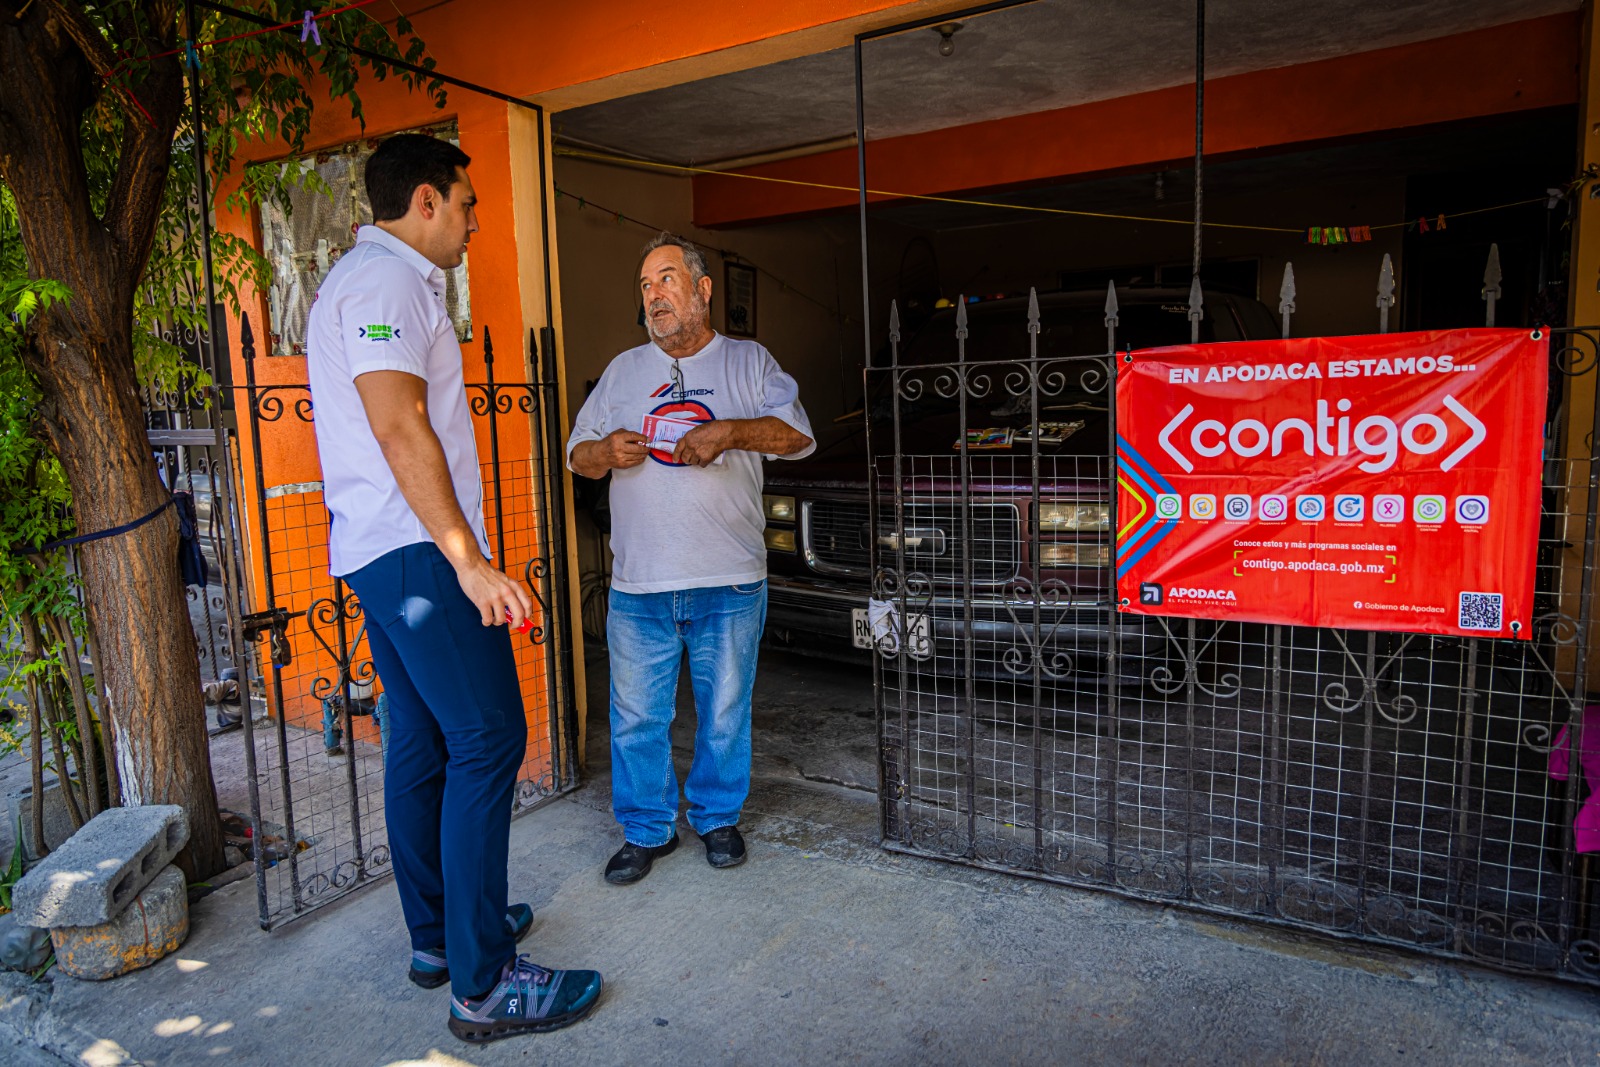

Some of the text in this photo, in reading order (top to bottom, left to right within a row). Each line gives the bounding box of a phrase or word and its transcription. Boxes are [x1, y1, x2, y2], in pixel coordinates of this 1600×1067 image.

[1169, 355, 1477, 384] EN APODACA ESTAMOS...
[671, 389, 714, 399] CEMEX
[1233, 539, 1397, 552] Conoce estos y más programas sociales en
[1242, 558, 1385, 575] contigo.apodaca.gob.mx
[1168, 588, 1236, 600] APODACA
[1364, 602, 1446, 614] Gobierno de Apodaca
